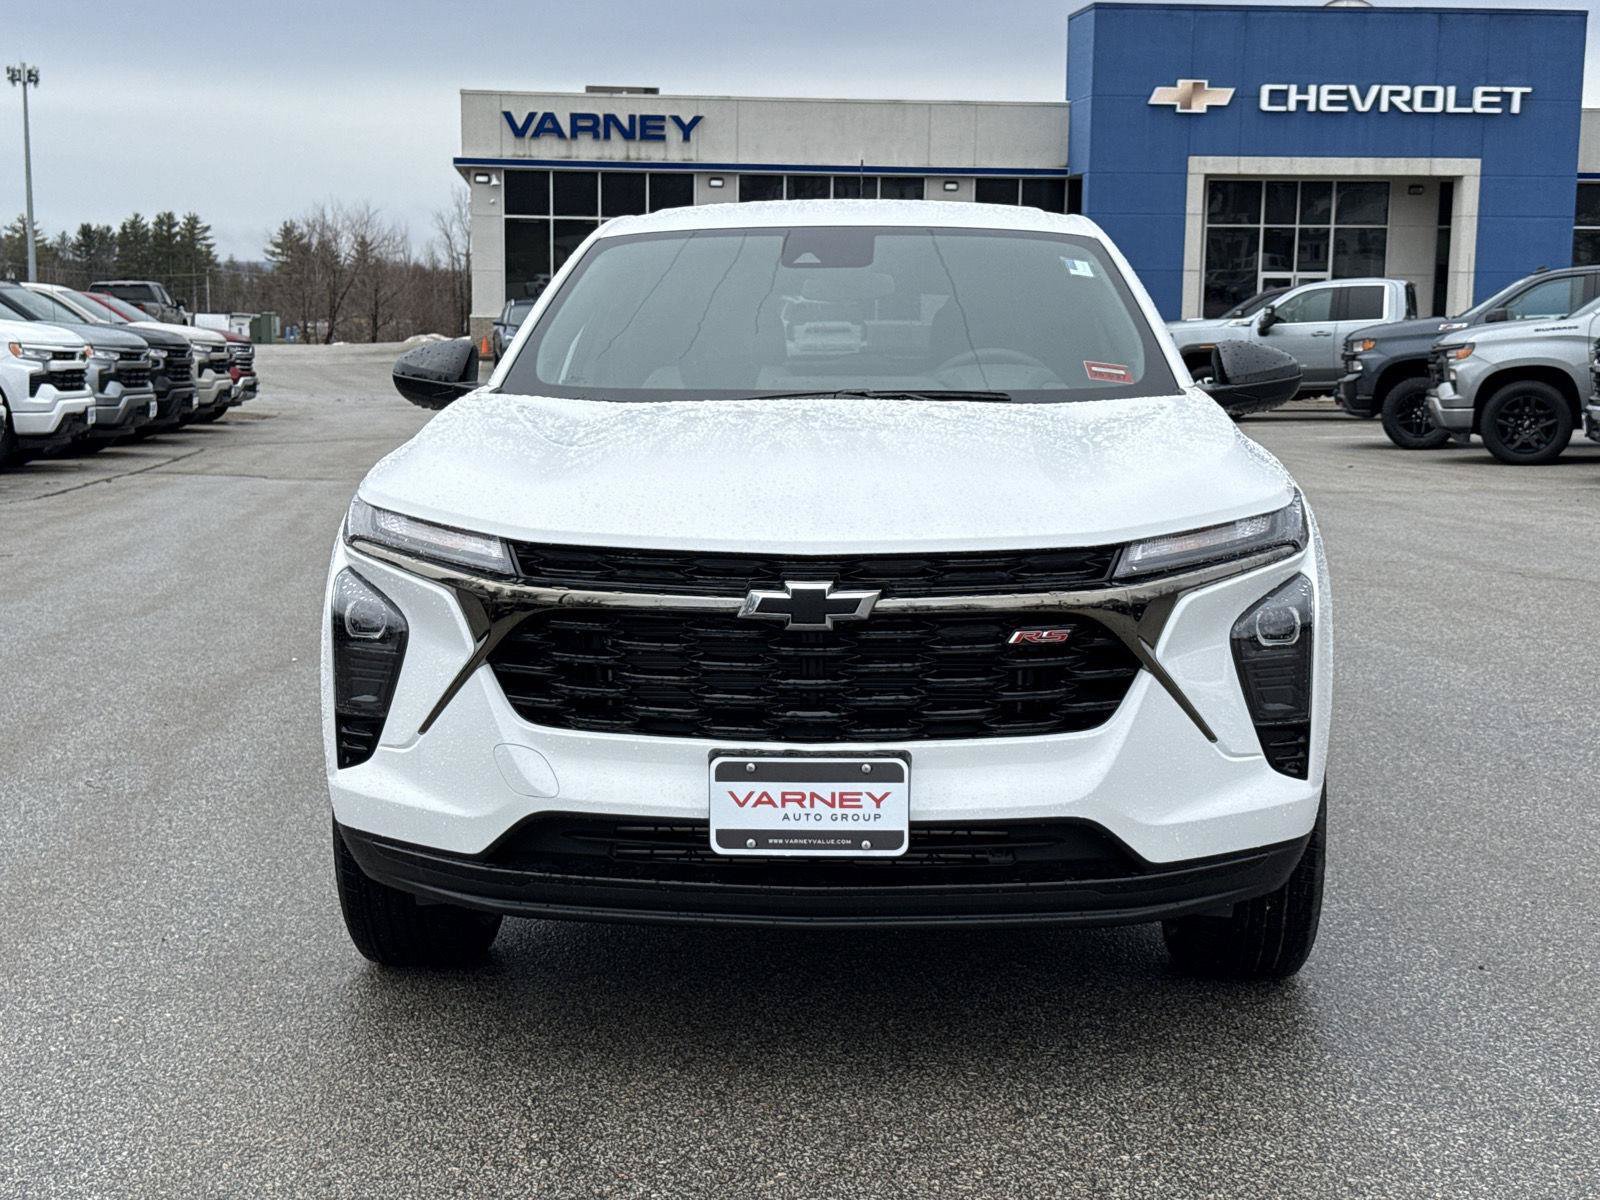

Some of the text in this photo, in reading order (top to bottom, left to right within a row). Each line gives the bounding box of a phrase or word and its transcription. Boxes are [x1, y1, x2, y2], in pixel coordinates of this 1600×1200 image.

[1259, 84, 1533, 114] CHEVROLET
[502, 111, 704, 142] VARNEY
[1008, 629, 1071, 643] RS
[727, 790, 892, 809] VARNEY
[782, 812, 882, 822] AUTO GROUP
